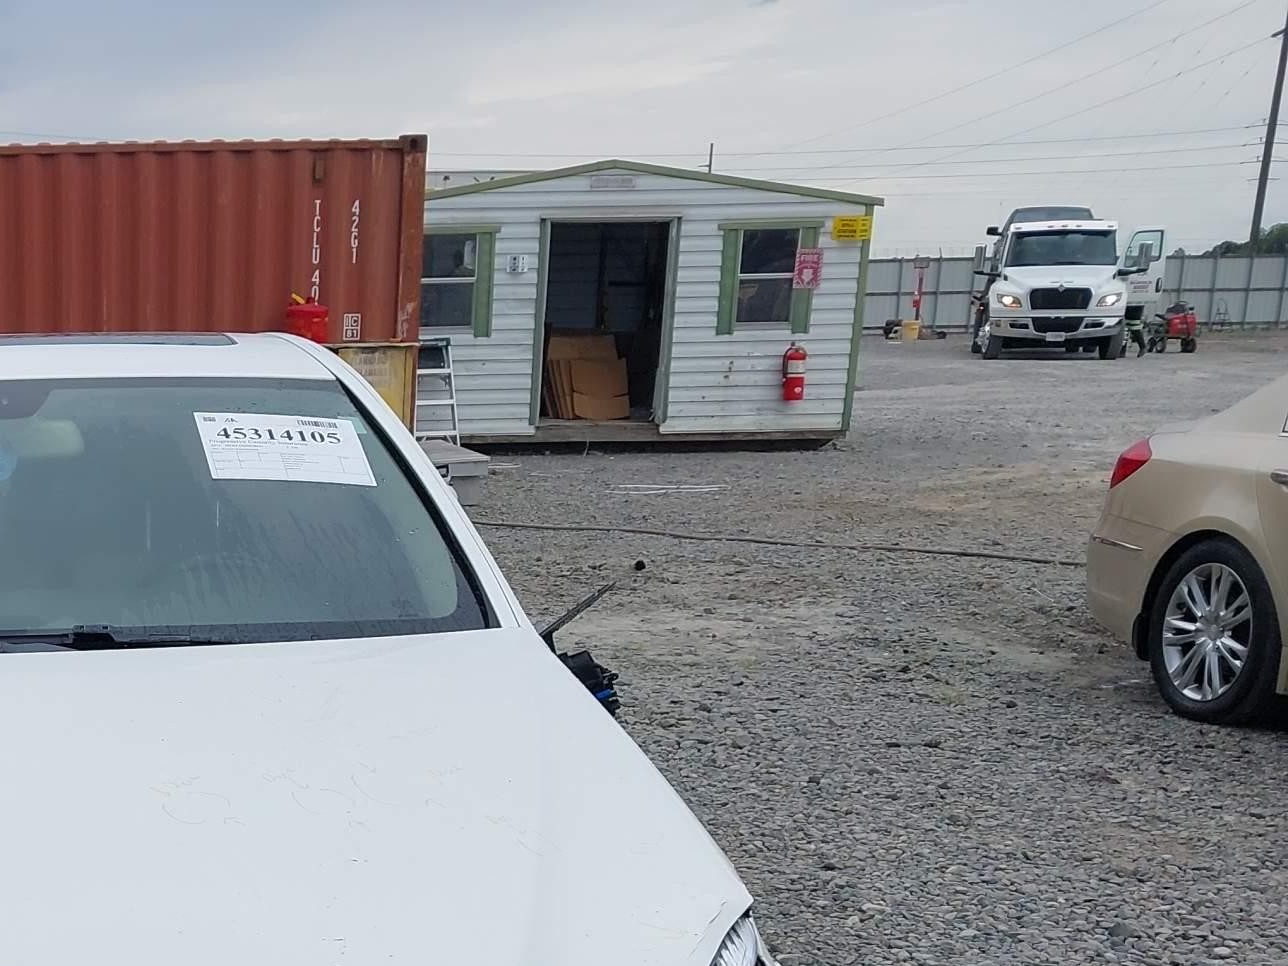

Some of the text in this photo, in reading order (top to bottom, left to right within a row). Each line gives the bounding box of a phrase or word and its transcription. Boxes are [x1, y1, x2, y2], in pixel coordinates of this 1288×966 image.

[312, 200, 321, 306] TCLU 40
[351, 200, 360, 264] 42G1
[216, 426, 342, 445] 45314105
